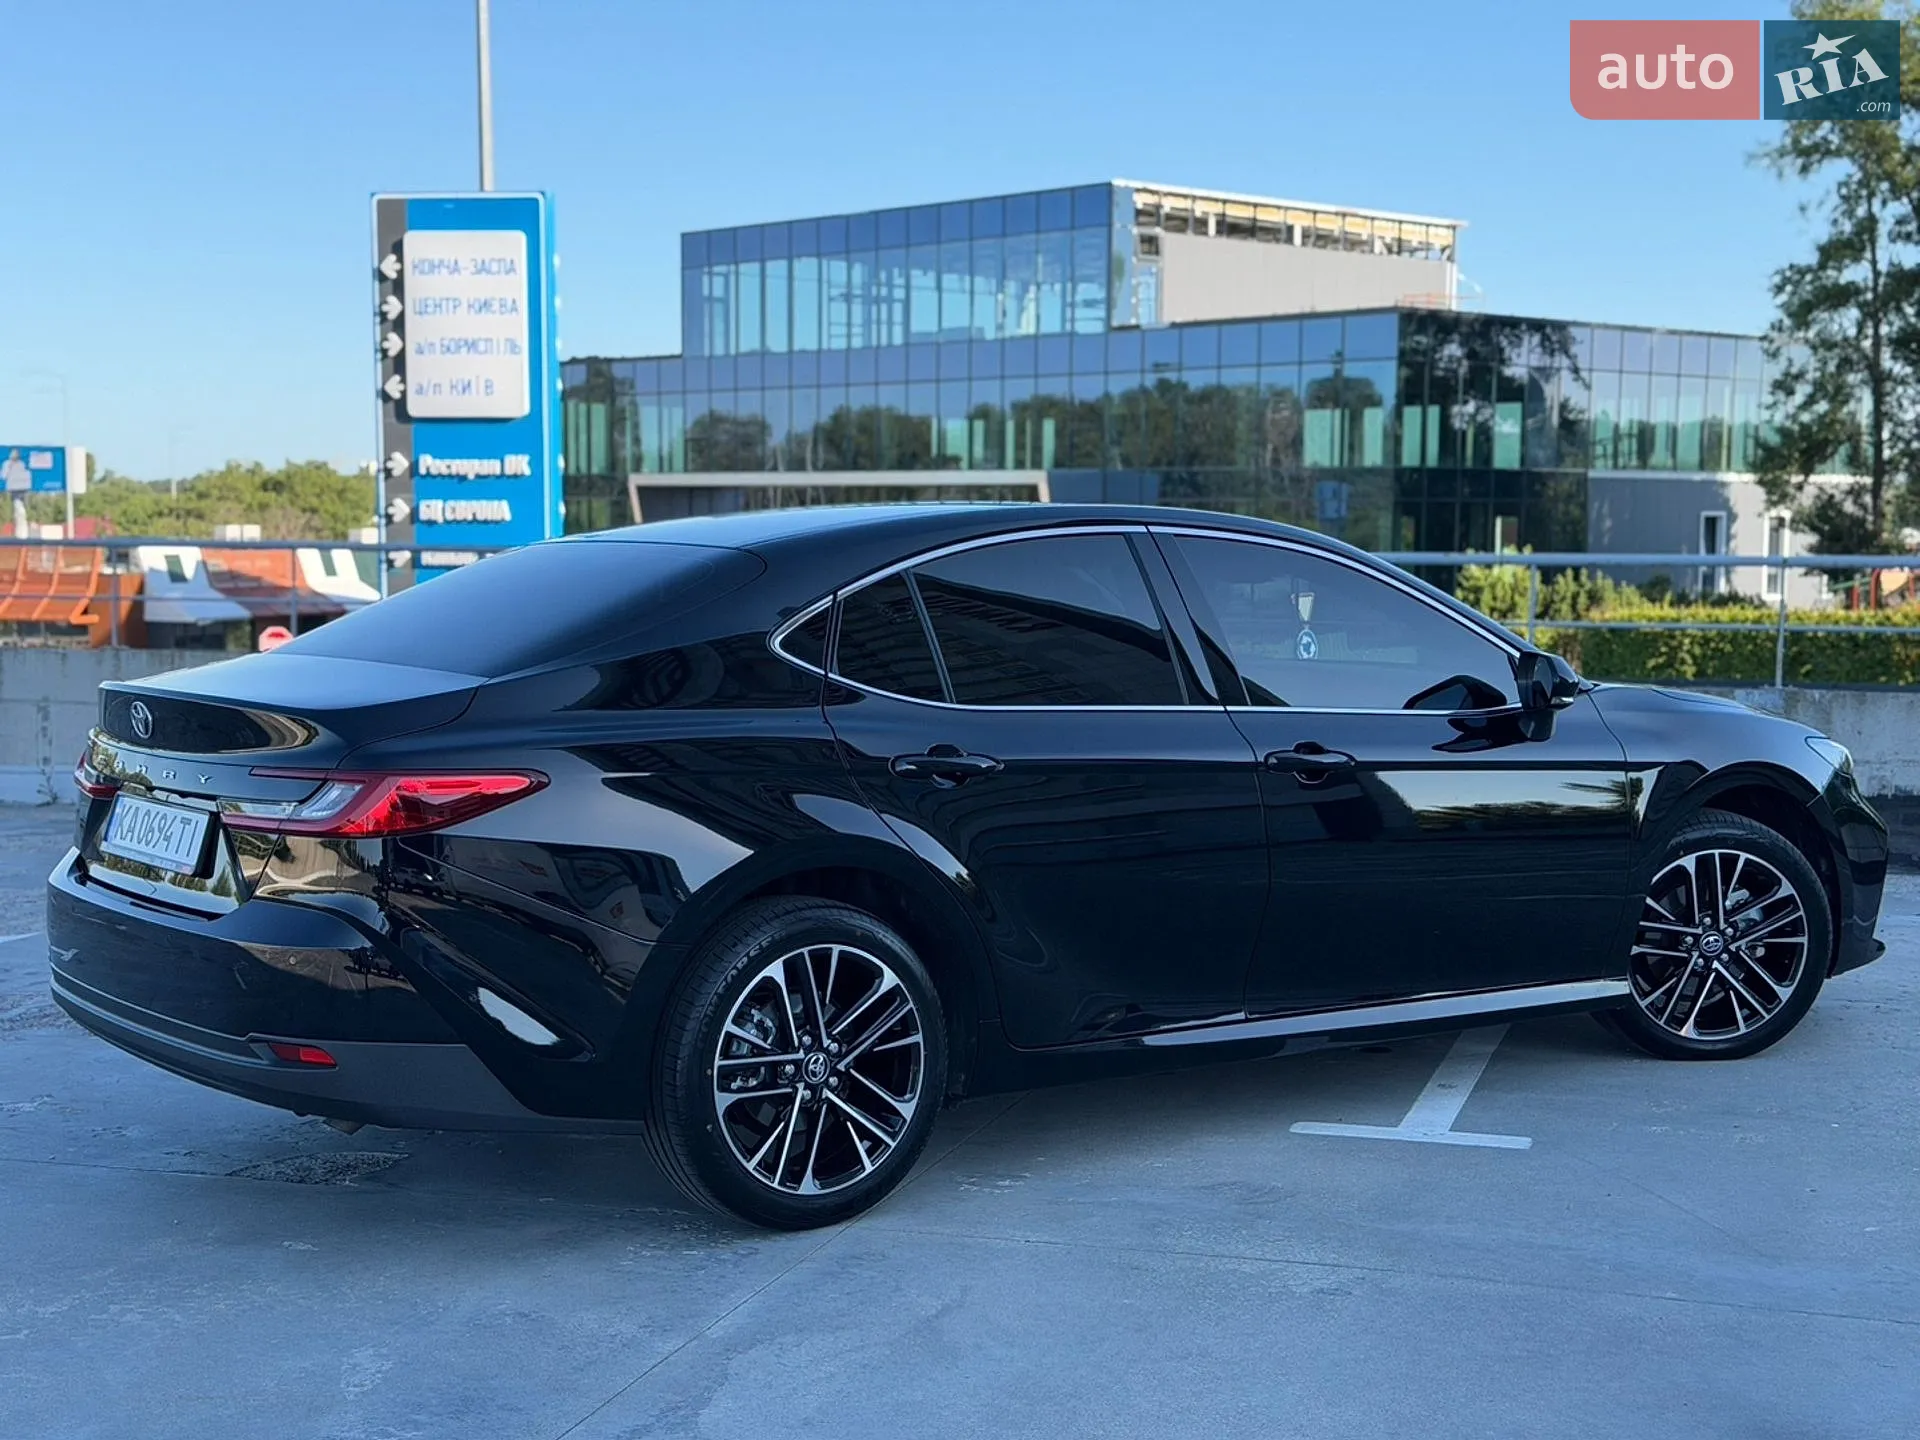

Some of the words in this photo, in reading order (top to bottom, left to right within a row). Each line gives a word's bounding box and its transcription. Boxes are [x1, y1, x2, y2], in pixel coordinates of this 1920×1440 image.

[411, 257, 517, 276] КОНЧА-ЗАСПА
[412, 297, 462, 317] ЦЕНТР
[467, 297, 519, 315] КИЄВА
